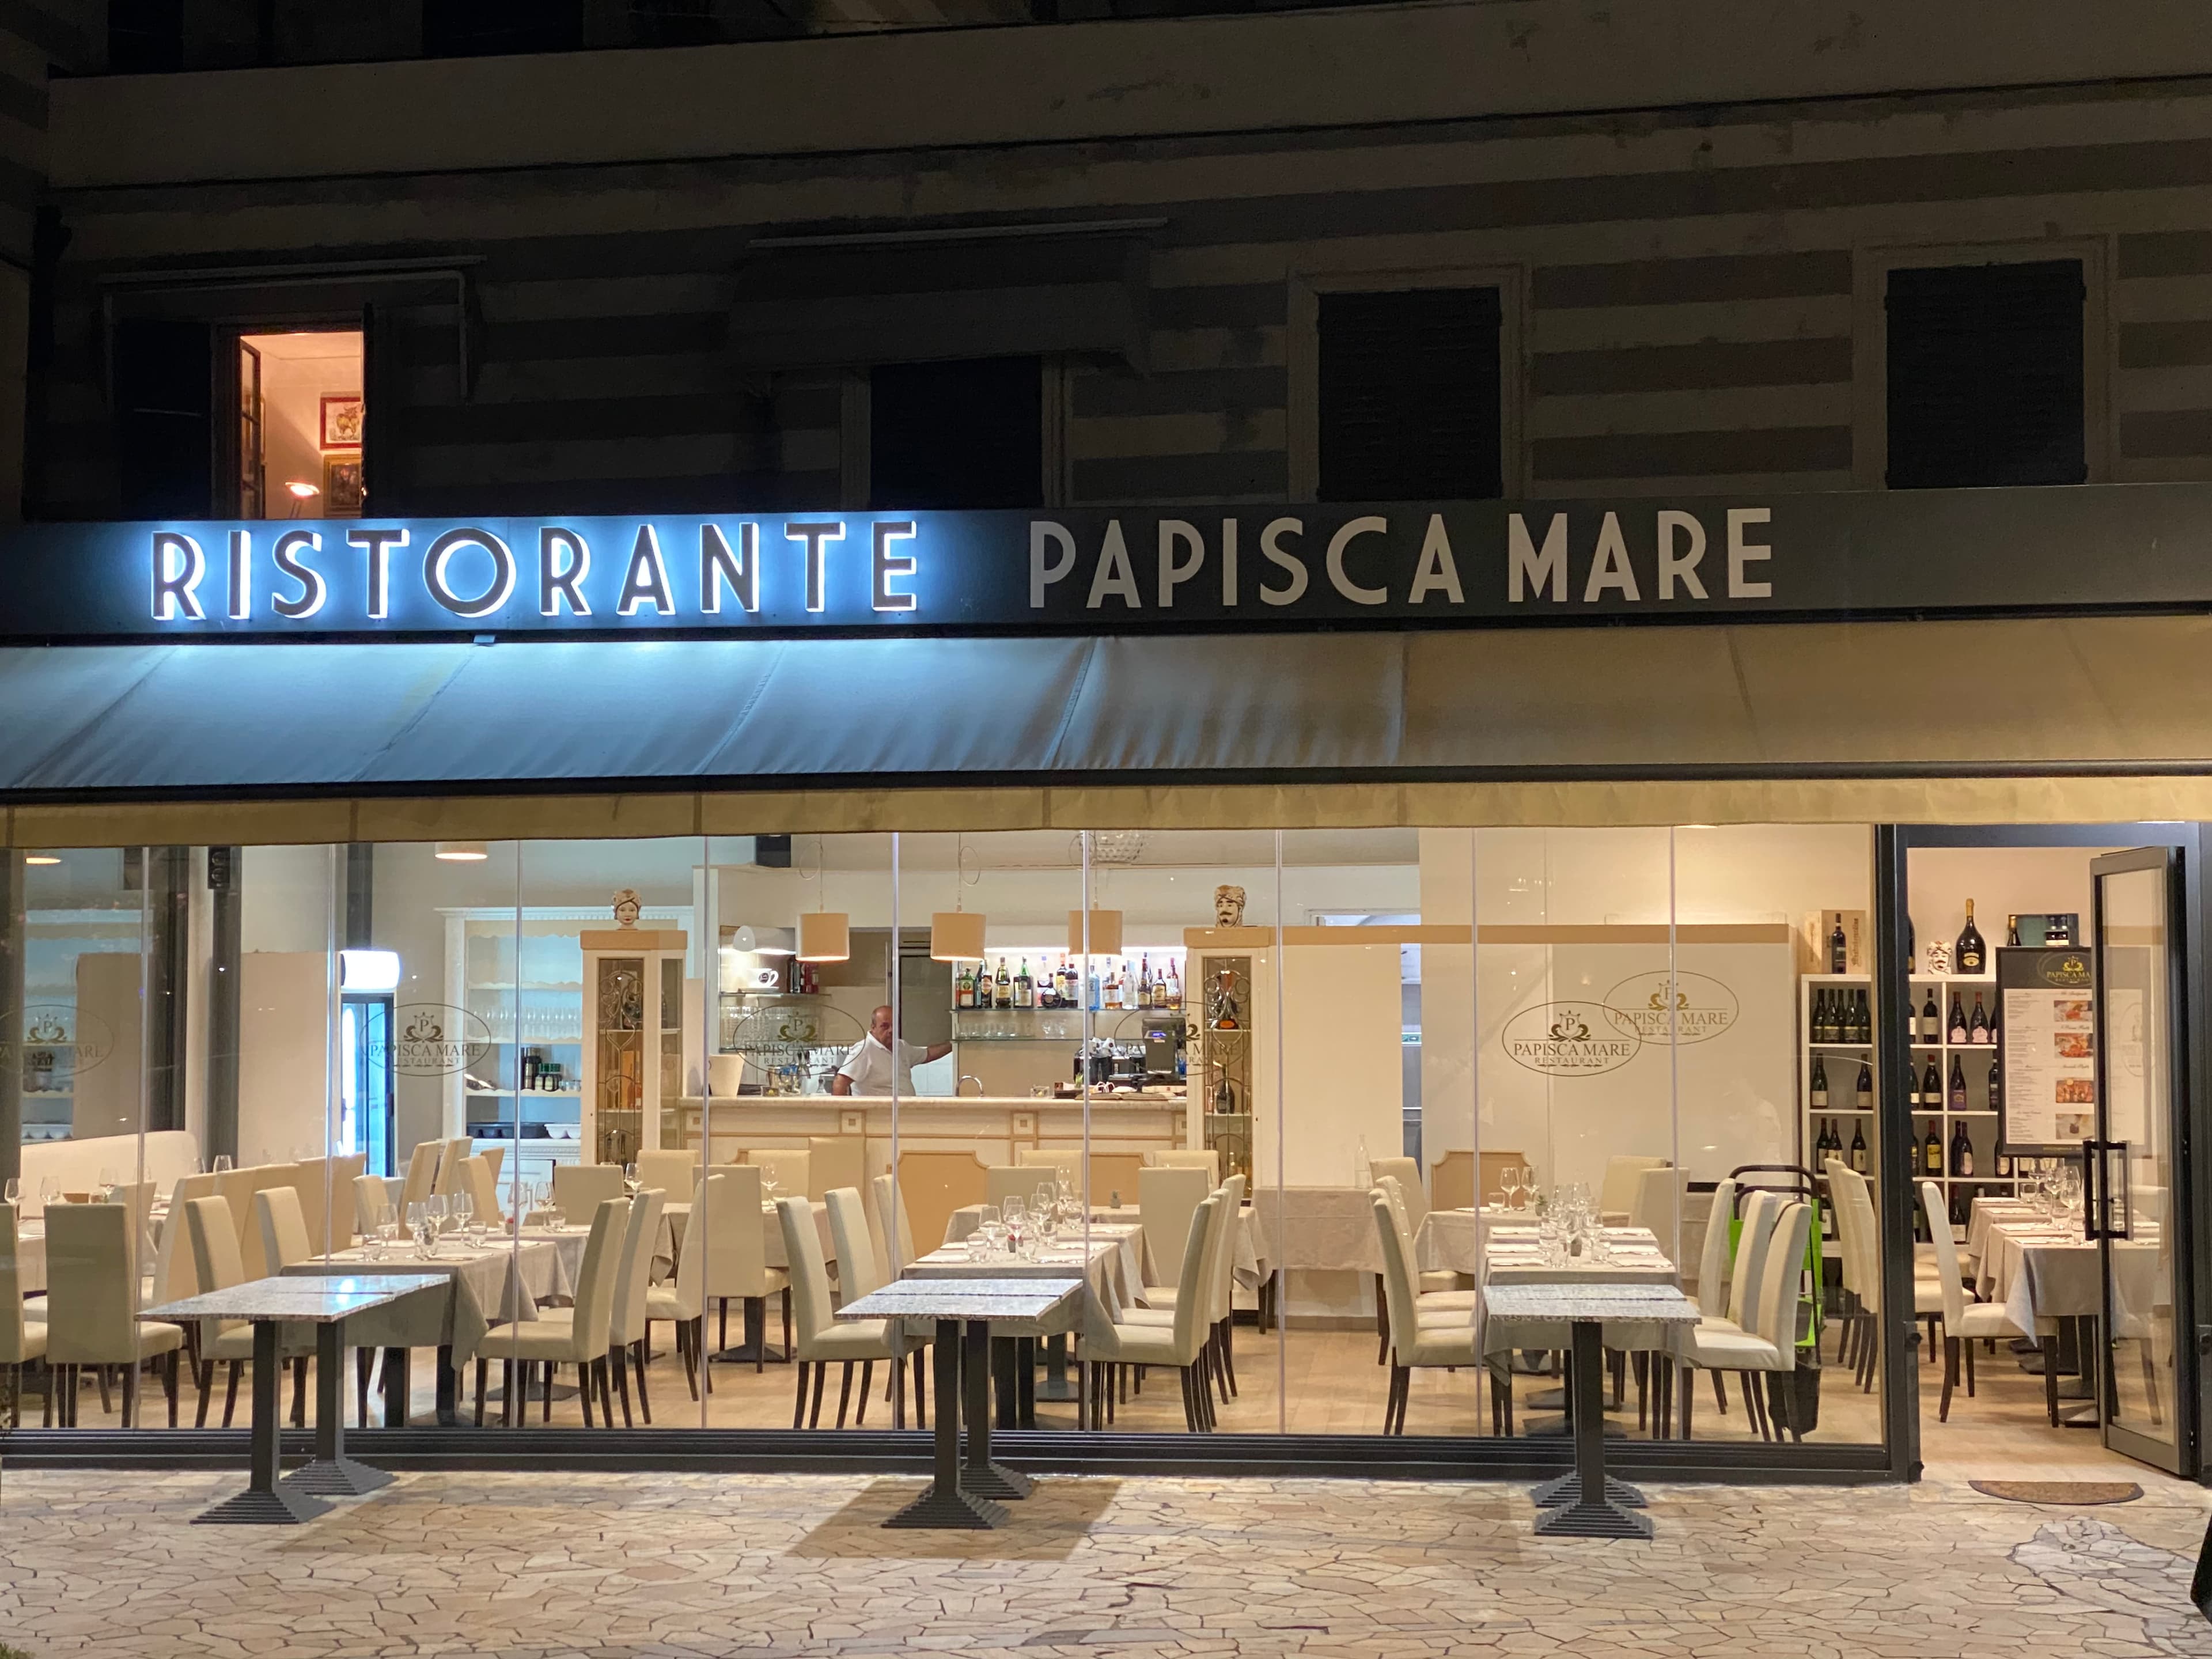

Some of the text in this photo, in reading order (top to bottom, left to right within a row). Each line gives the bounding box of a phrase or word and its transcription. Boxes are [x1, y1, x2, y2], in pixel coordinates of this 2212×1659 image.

[151, 508, 1772, 620] RISTORANTE PAPISCA MARE
[1566, 1017, 1575, 1031] P
[1681, 1013, 1728, 1025] MARE
[44, 1021, 52, 1033] P
[420, 1019, 429, 1032] P
[794, 1020, 803, 1031] P
[436, 1044, 480, 1056] MARE
[1514, 1043, 1630, 1055] PAPISCA MARE
